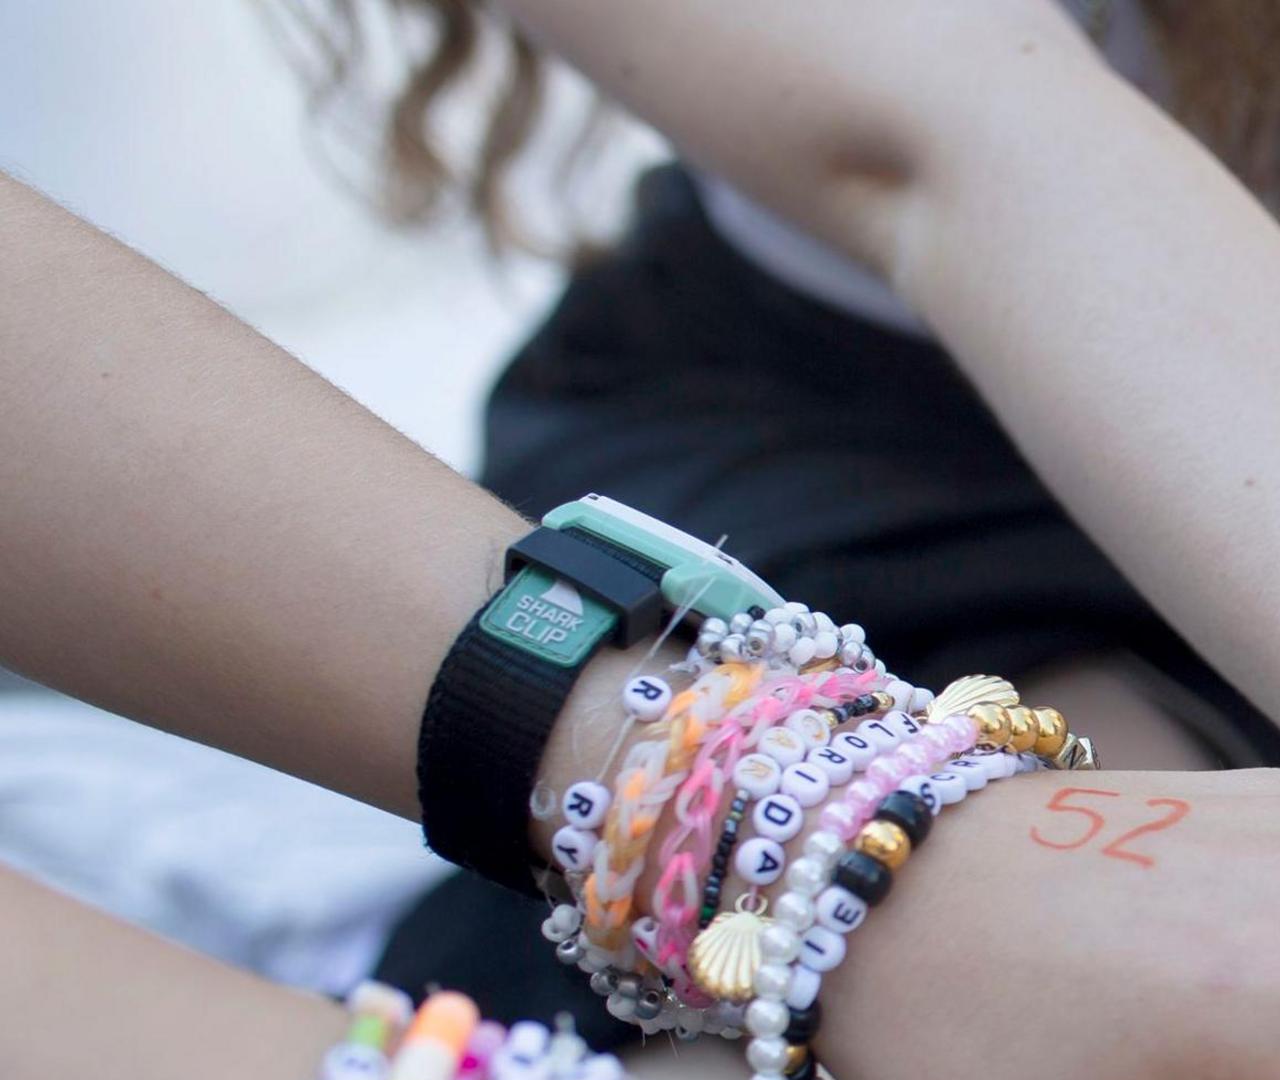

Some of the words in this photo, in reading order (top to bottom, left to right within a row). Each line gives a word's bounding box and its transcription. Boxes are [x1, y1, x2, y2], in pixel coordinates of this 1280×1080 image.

[506, 611, 568, 645] CLIP
[516, 594, 584, 632] SHARK
[756, 713, 919, 876] FLORIDA
[1030, 787, 1191, 869] 52
